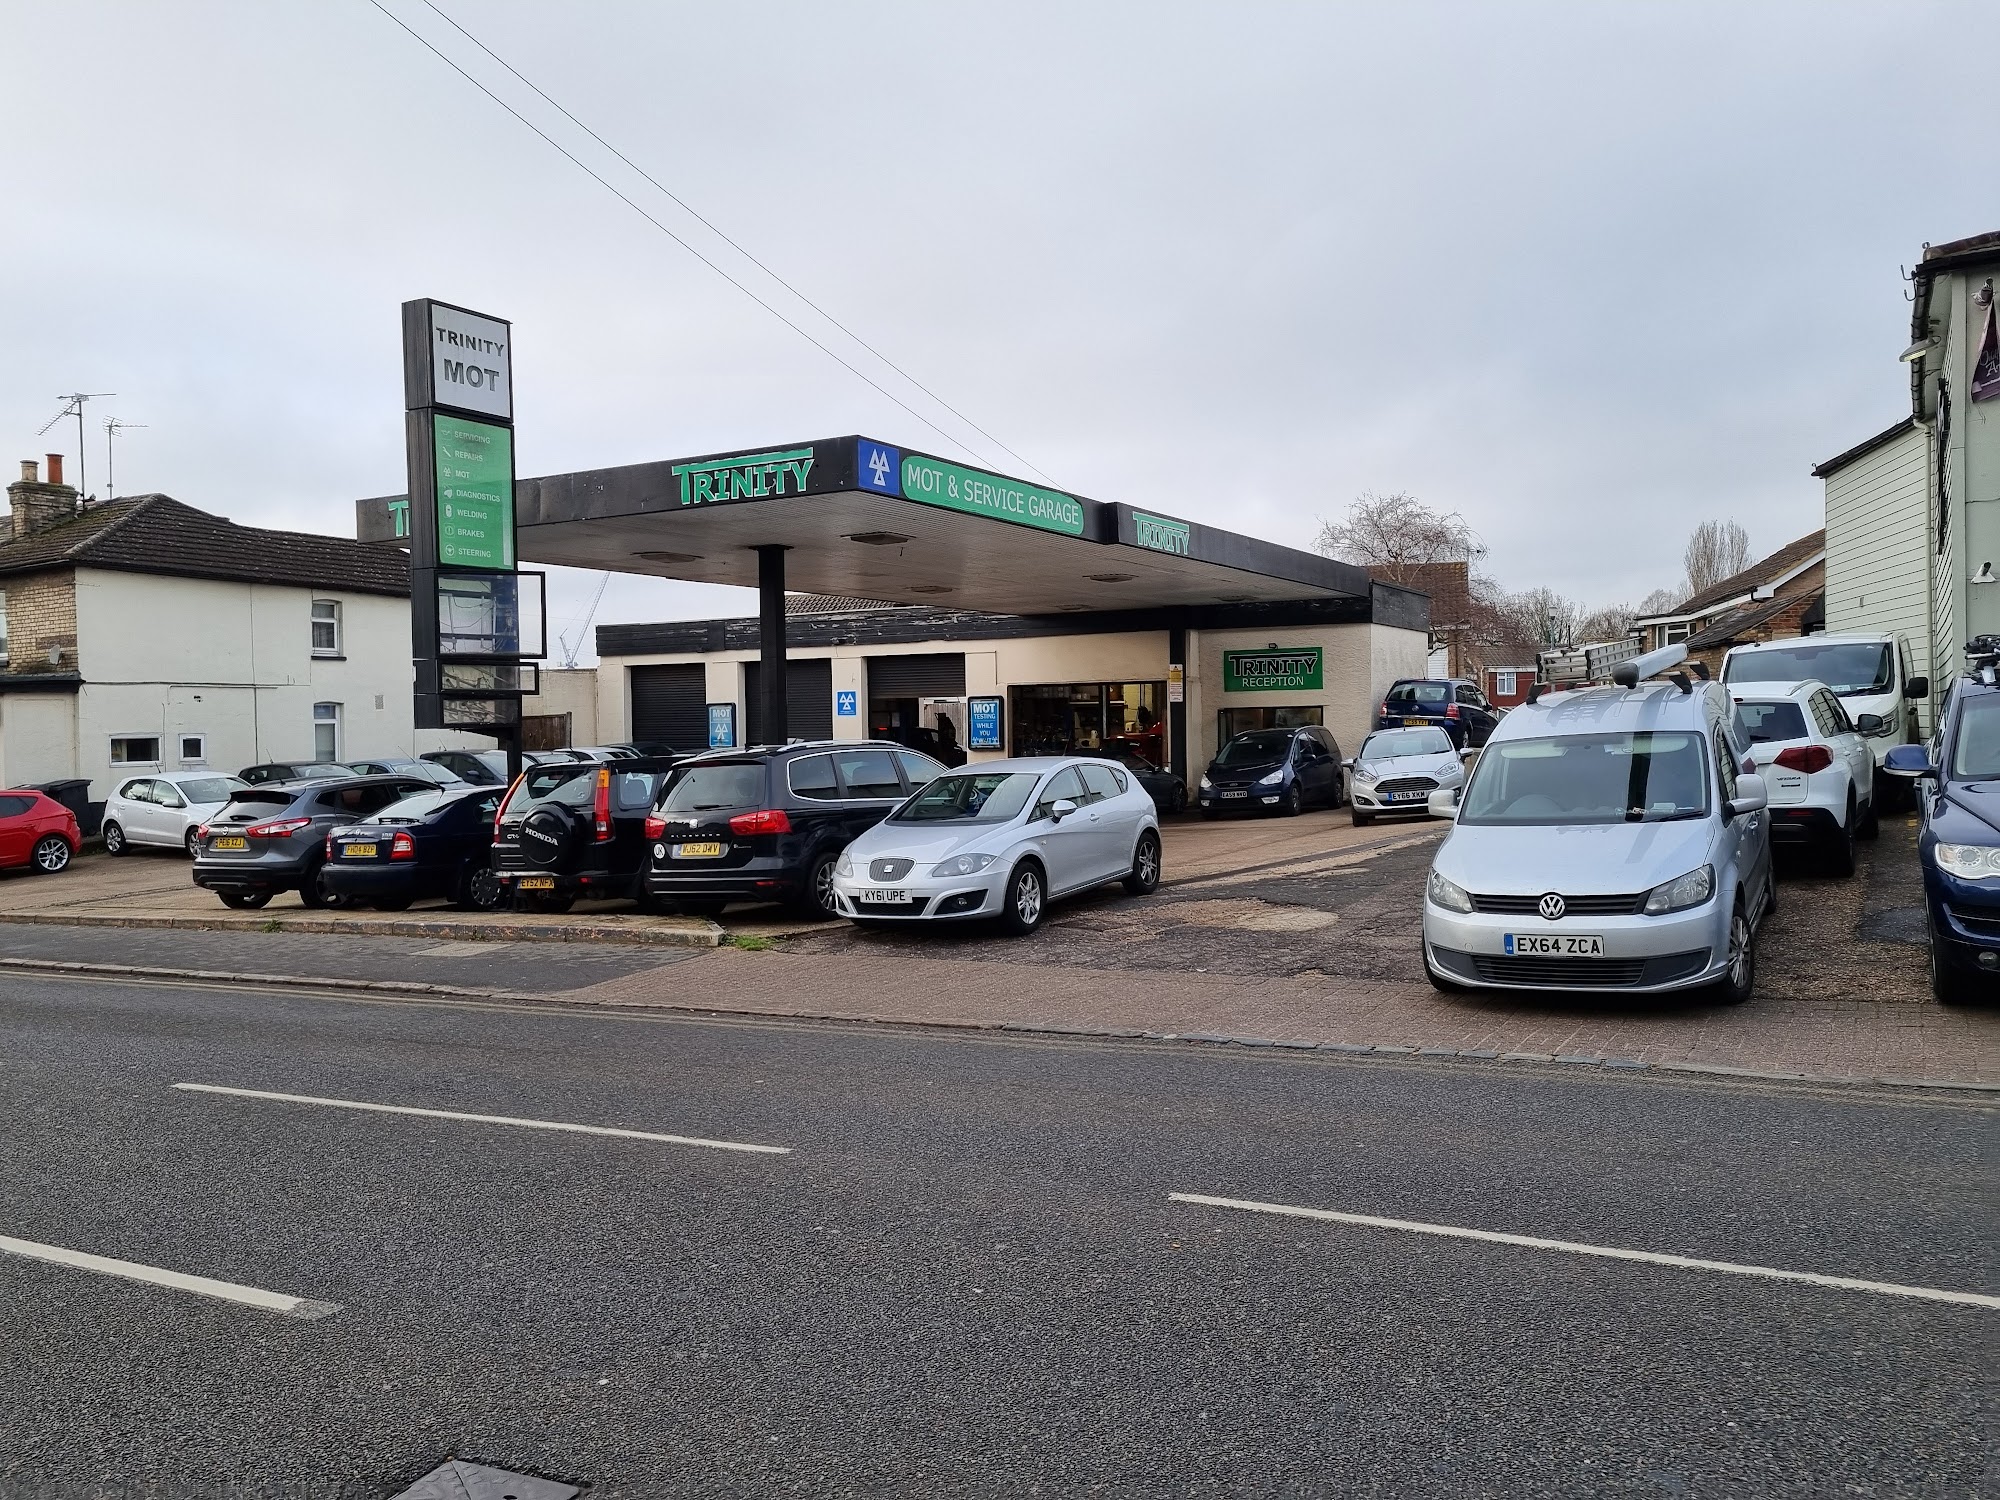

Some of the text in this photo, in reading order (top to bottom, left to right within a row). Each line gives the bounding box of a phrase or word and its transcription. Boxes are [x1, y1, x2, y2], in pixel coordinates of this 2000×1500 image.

[435, 326, 505, 357] TRINITY
[443, 358, 500, 391] MOT
[454, 430, 491, 444] SERVICING
[454, 450, 483, 461] REPAIRS
[455, 470, 470, 478] MOT
[672, 447, 815, 505] TRINITY
[456, 489, 500, 502] DIAGNOSTICS
[908, 464, 1079, 525] MOT & SERVICE GARAGE
[457, 509, 487, 519] WELDING
[457, 528, 484, 538] BRAKES
[1132, 511, 1190, 555] TRINITY
[458, 548, 491, 557] STEERING
[1228, 652, 1318, 677] TRINITY
[1242, 676, 1304, 688] RECEPTION
[712, 709, 731, 718] MOT
[973, 703, 996, 714] MOT
[524, 826, 559, 846] HONDA
[865, 890, 906, 901] KY61 UPE
[1517, 937, 1601, 954] EX64 ZCA
